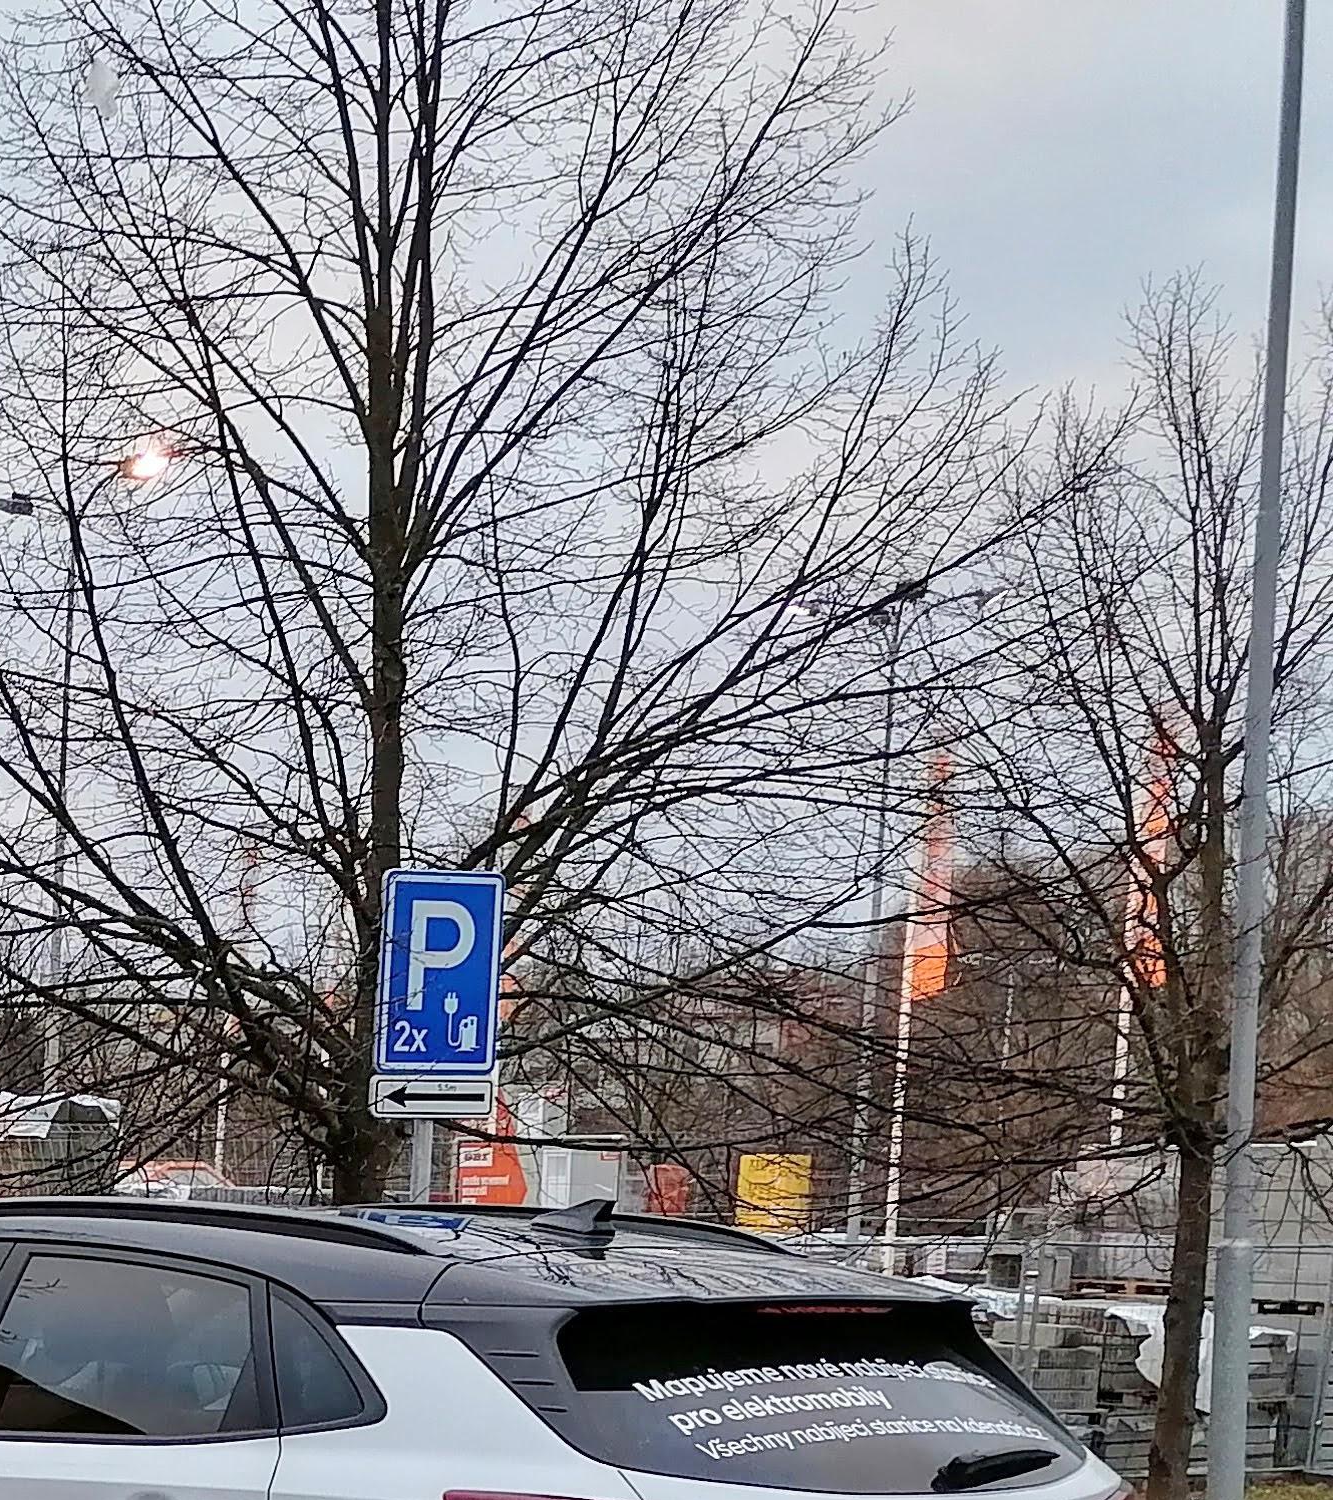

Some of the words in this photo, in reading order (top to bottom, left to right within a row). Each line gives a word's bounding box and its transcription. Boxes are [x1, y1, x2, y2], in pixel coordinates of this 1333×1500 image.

[406, 900, 475, 1011] P
[393, 1020, 428, 1052] 2x
[633, 1366, 784, 1402] Mapujeme
[778, 1358, 844, 1381] nové
[667, 1408, 723, 1436] pro
[721, 1385, 893, 1421] elektromobily
[694, 1431, 796, 1460] Všechny
[791, 1418, 873, 1445] nabíjecí
[869, 1416, 938, 1435] stanice
[934, 1419, 959, 1433] na
[954, 1416, 1049, 1441] kdenabit.cz
